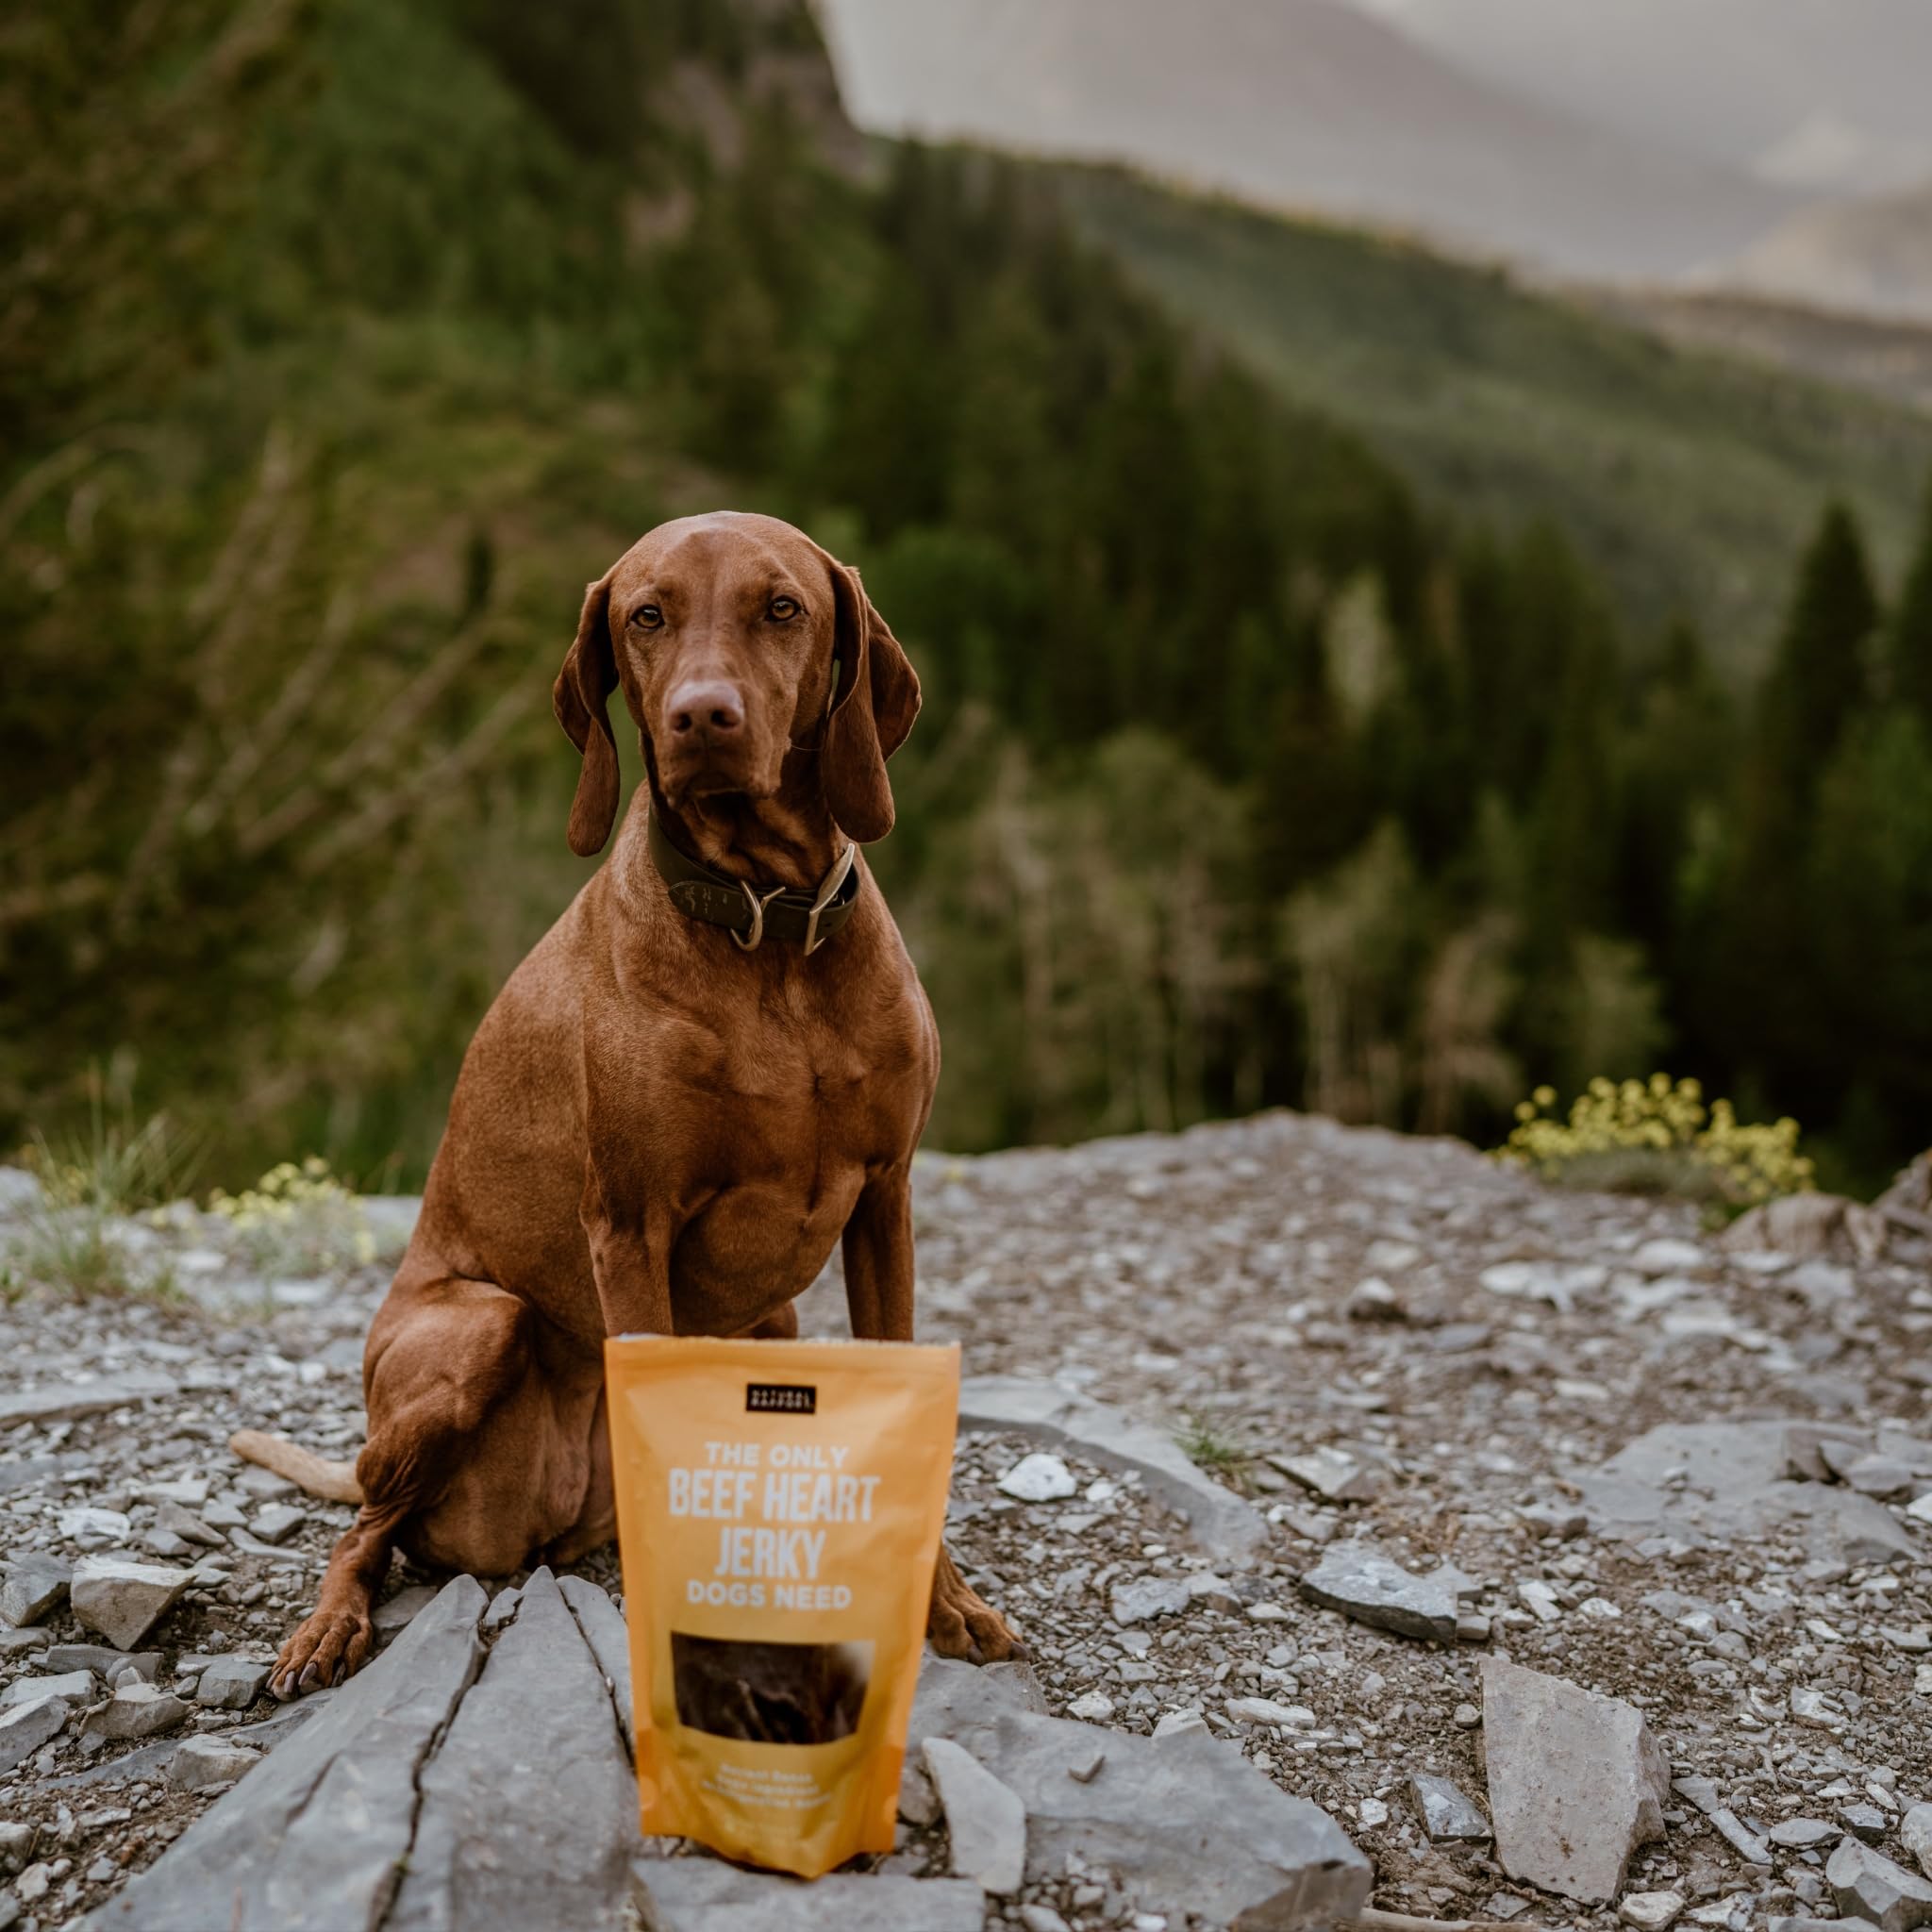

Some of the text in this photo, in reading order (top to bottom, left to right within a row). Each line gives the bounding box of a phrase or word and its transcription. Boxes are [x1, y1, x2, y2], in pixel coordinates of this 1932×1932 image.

[706, 1442, 848, 1468] THE ONLY
[669, 1469, 881, 1523] BEEF HEART
[715, 1527, 825, 1579] JERKY
[688, 1581, 852, 1609] DOGS NEED
